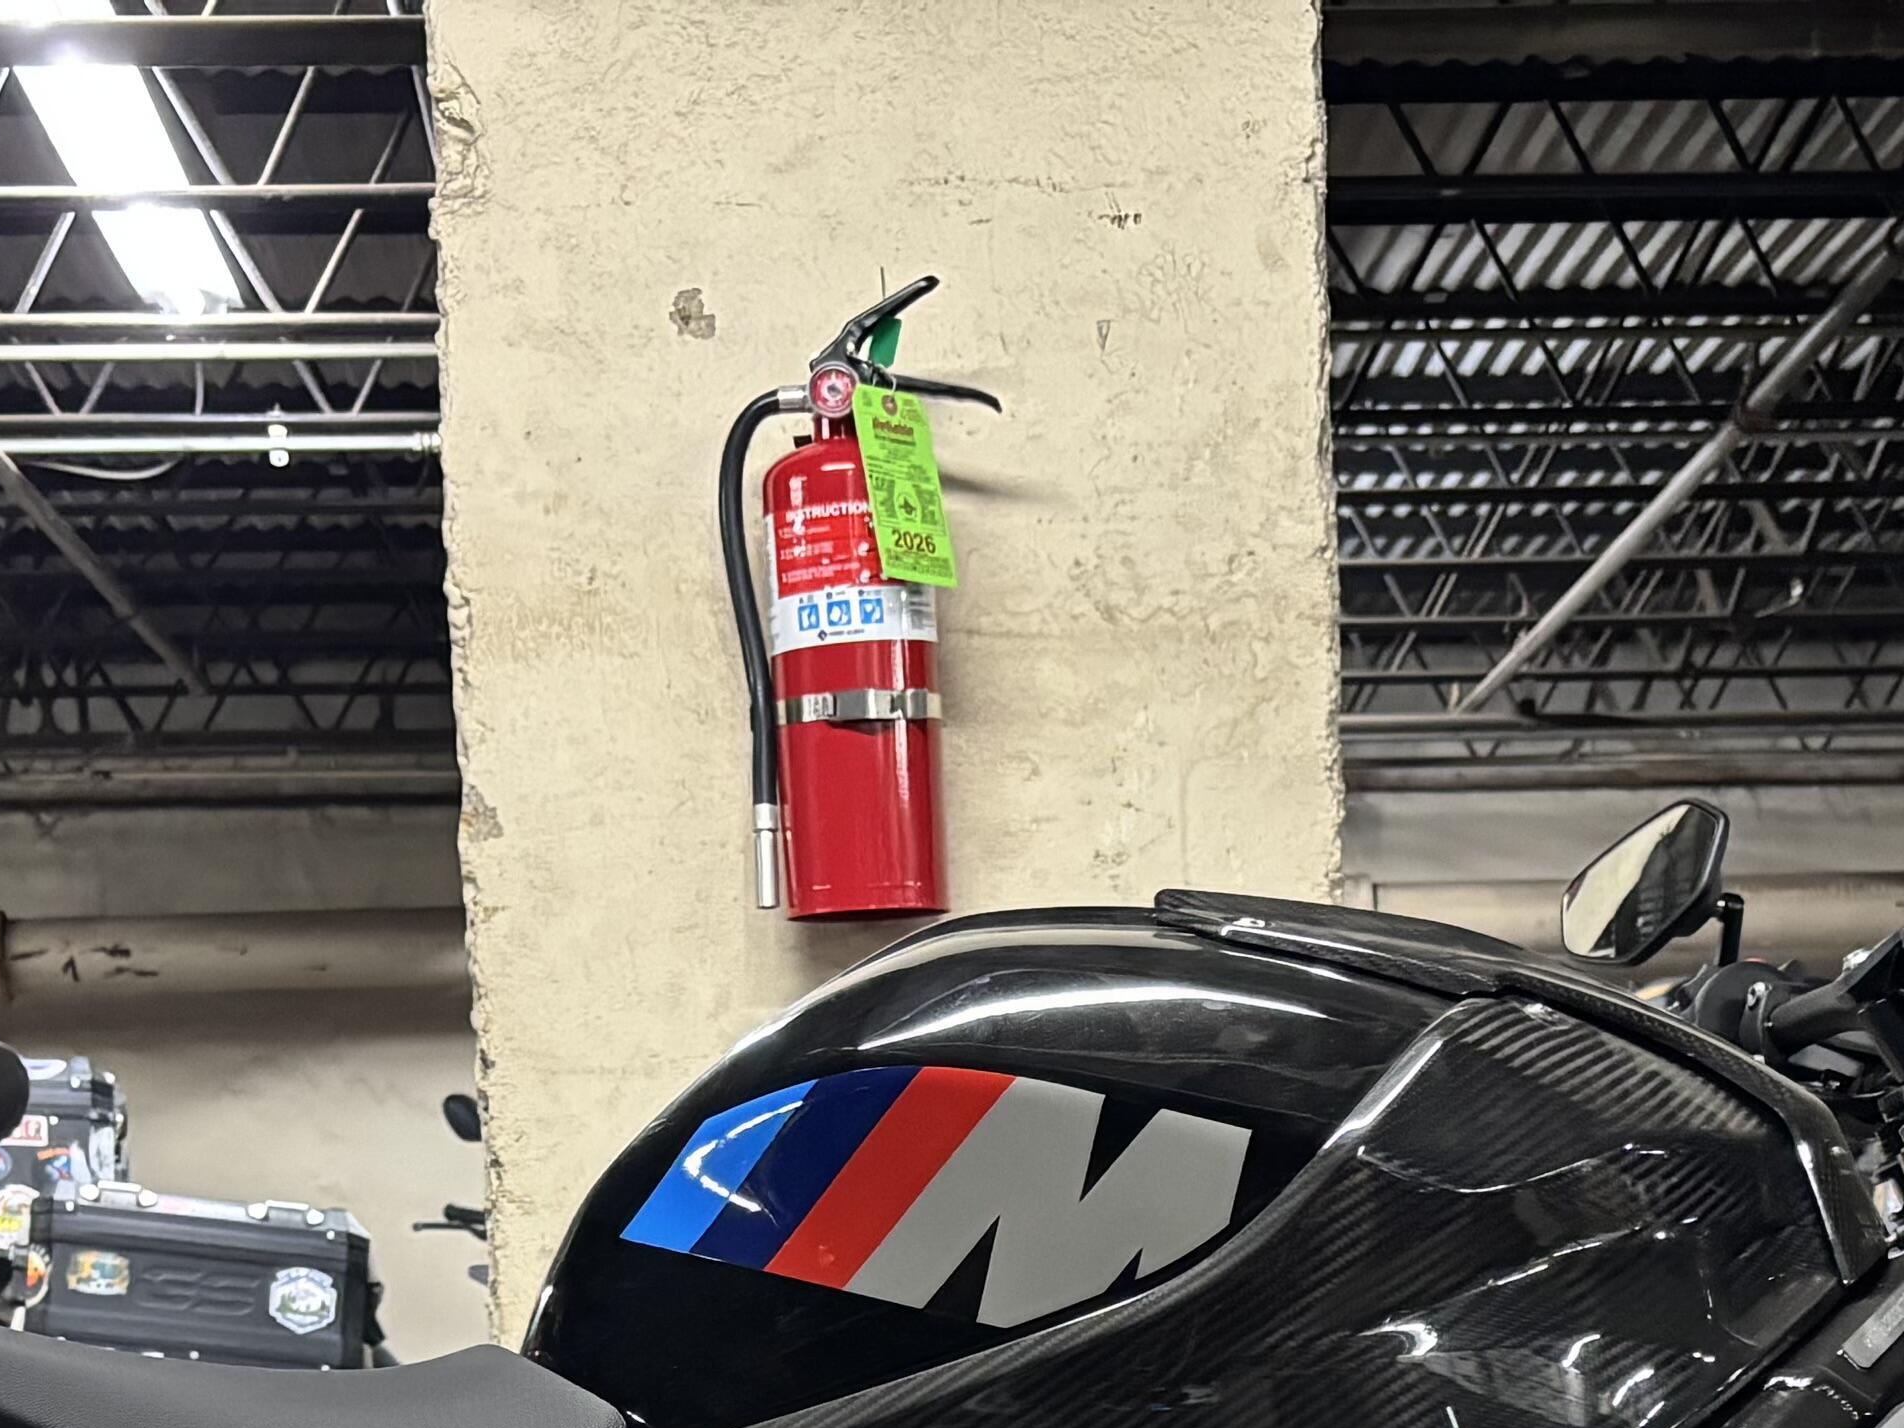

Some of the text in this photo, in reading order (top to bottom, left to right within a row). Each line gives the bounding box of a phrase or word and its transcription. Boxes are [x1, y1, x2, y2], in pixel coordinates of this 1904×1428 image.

[785, 502, 872, 523] INSTRUCTION
[892, 530, 937, 554] 2026
[844, 1076, 1253, 1329] M
